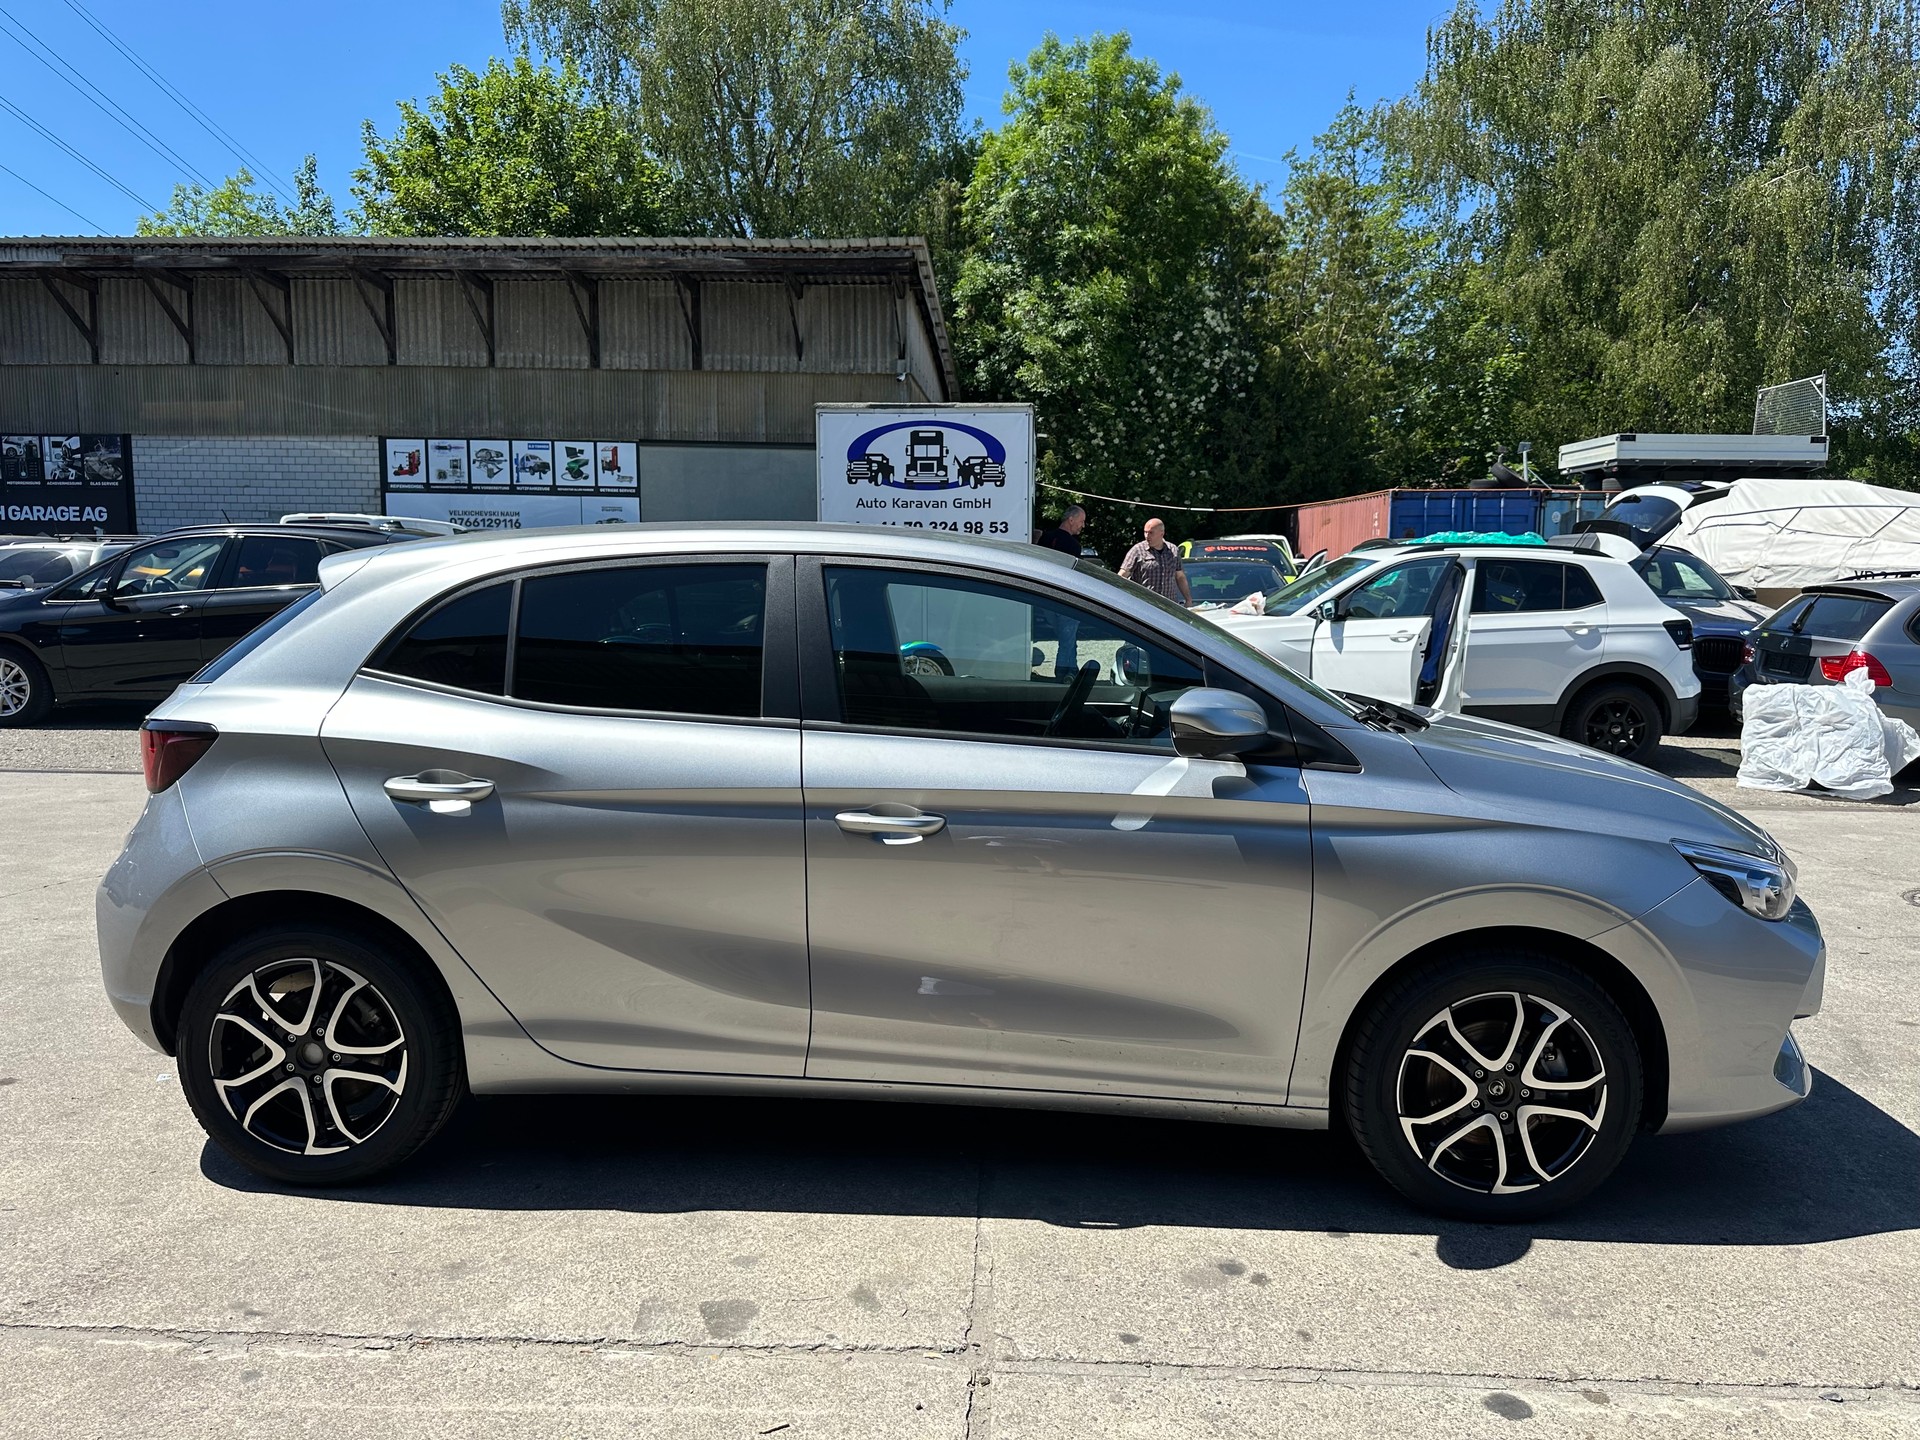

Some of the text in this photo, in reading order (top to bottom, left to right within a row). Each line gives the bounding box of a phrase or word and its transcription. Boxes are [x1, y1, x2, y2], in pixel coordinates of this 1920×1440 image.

[856, 497, 992, 509] Auto Karavan GmbH
[7, 505, 80, 521] GARAGE
[81, 506, 108, 522] AG
[449, 517, 522, 529] 0766129116
[963, 521, 984, 535] 98
[988, 521, 1009, 534] 53
